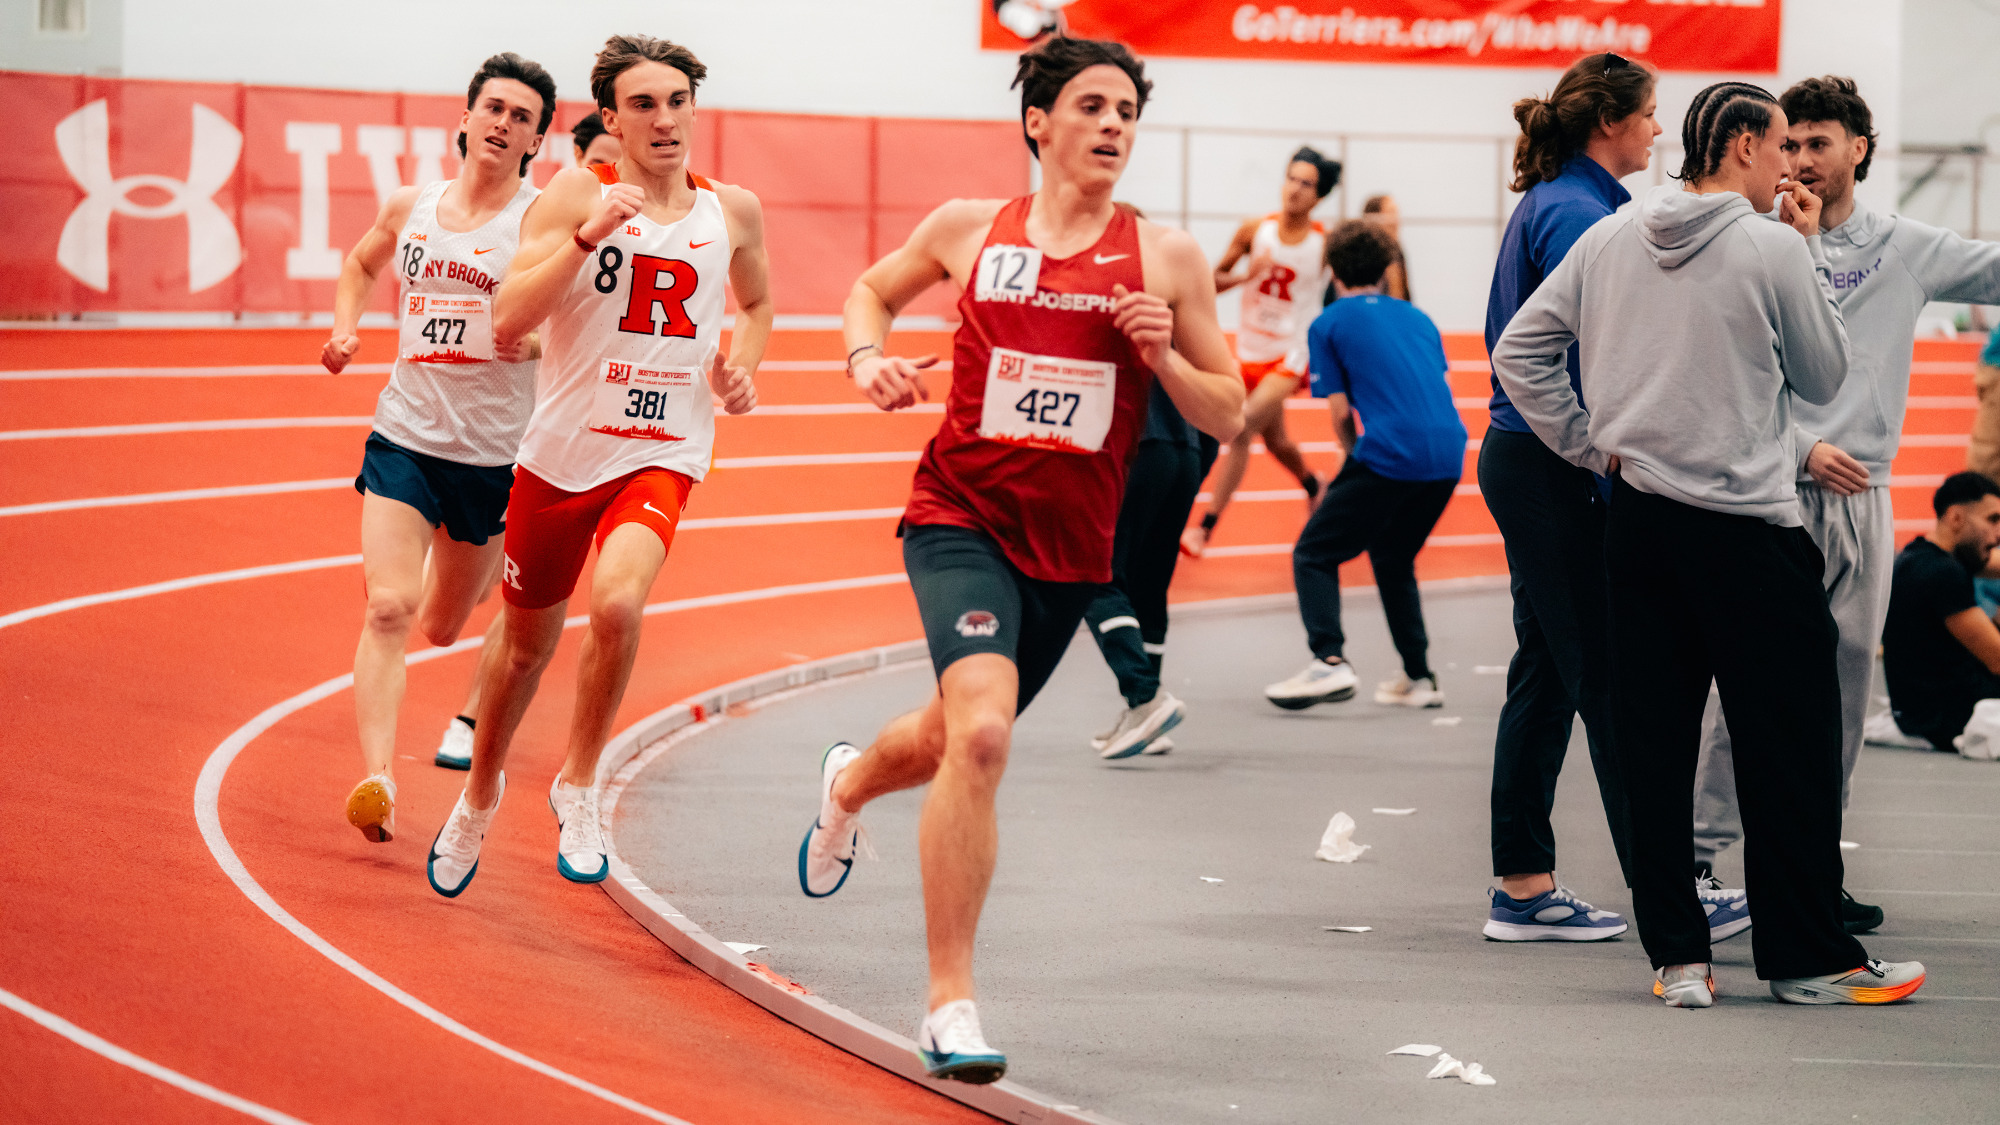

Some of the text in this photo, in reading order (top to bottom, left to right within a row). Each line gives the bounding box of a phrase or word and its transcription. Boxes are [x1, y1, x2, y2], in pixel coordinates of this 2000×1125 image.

[408, 233, 428, 242] CAA
[403, 242, 425, 278] 18
[447, 261, 501, 295] BROOK
[595, 245, 624, 294] 8
[991, 252, 1027, 290] 12
[618, 252, 699, 339] R
[1258, 264, 1297, 302] R
[1031, 290, 1117, 314] JOSEPH
[421, 318, 467, 345] 477
[606, 361, 692, 382] BU BOSTON UNIVERSITY
[624, 388, 668, 421] 381
[1015, 388, 1081, 428] 427
[502, 552, 523, 591] R
